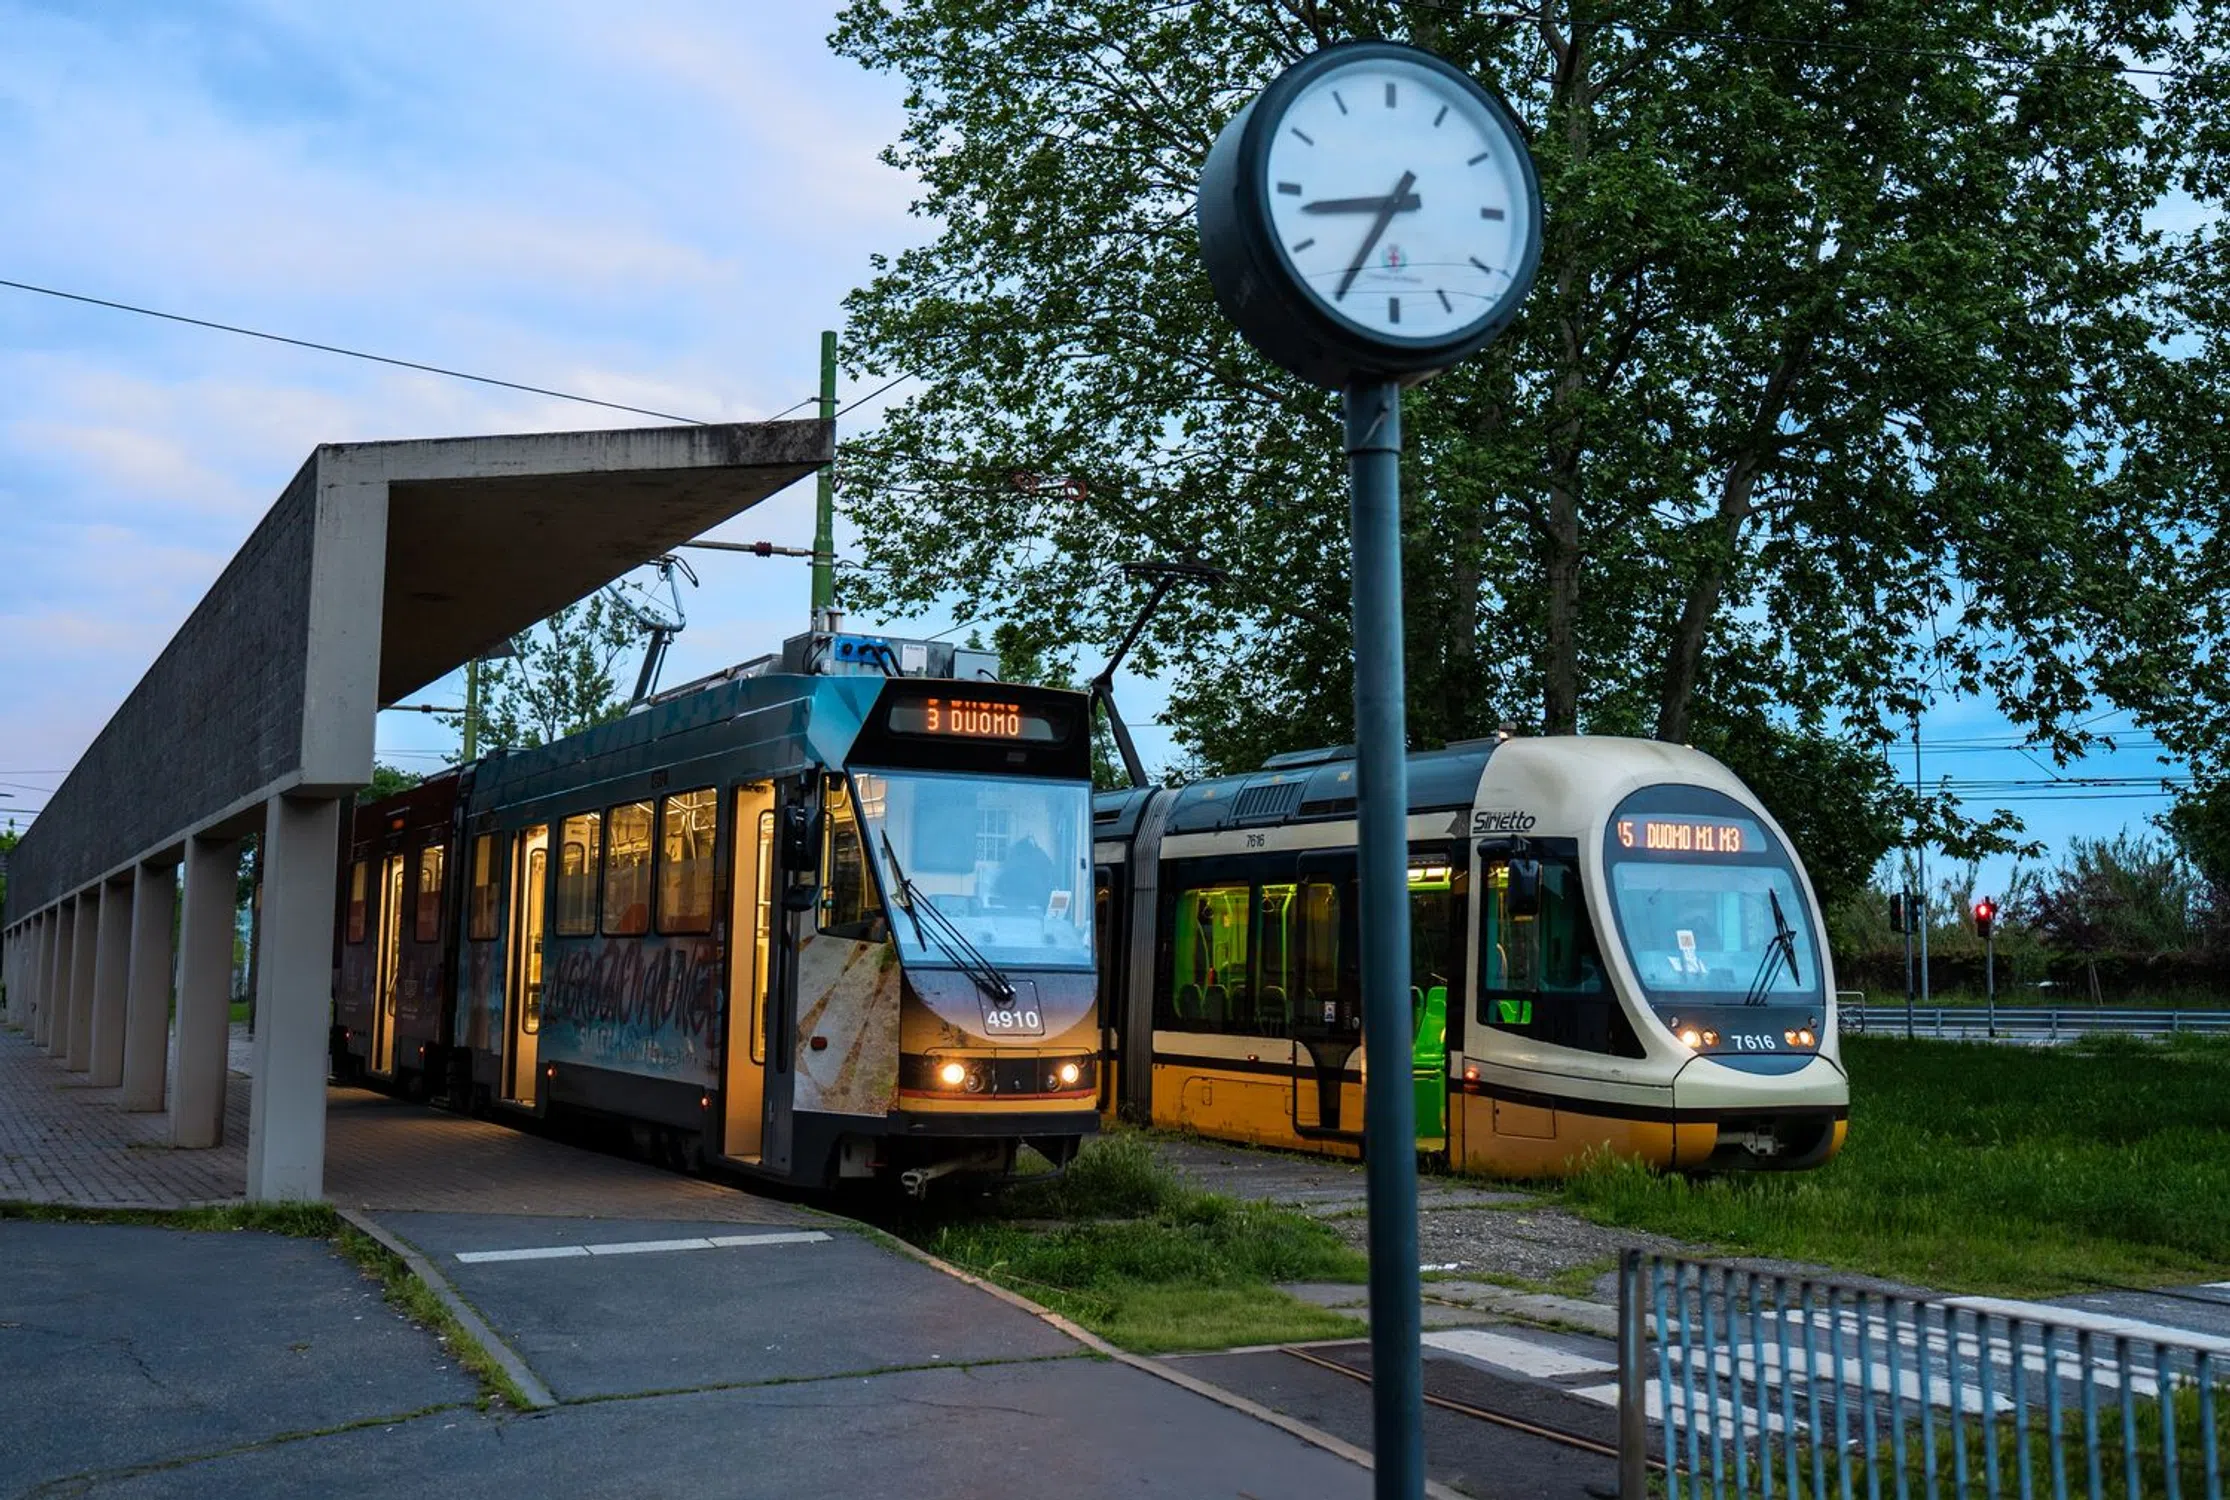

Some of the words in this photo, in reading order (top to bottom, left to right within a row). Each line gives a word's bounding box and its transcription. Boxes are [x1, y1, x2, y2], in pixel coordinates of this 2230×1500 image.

[927, 708, 940, 731] 3
[951, 710, 1019, 736] DUOMO
[1473, 811, 1536, 831] Sirietto
[1647, 823, 1691, 850] DUOMO
[1695, 825, 1715, 851] M1
[1719, 827, 1740, 852] M3
[987, 1010, 1039, 1028] 4910
[1731, 1034, 1776, 1050] 7616
